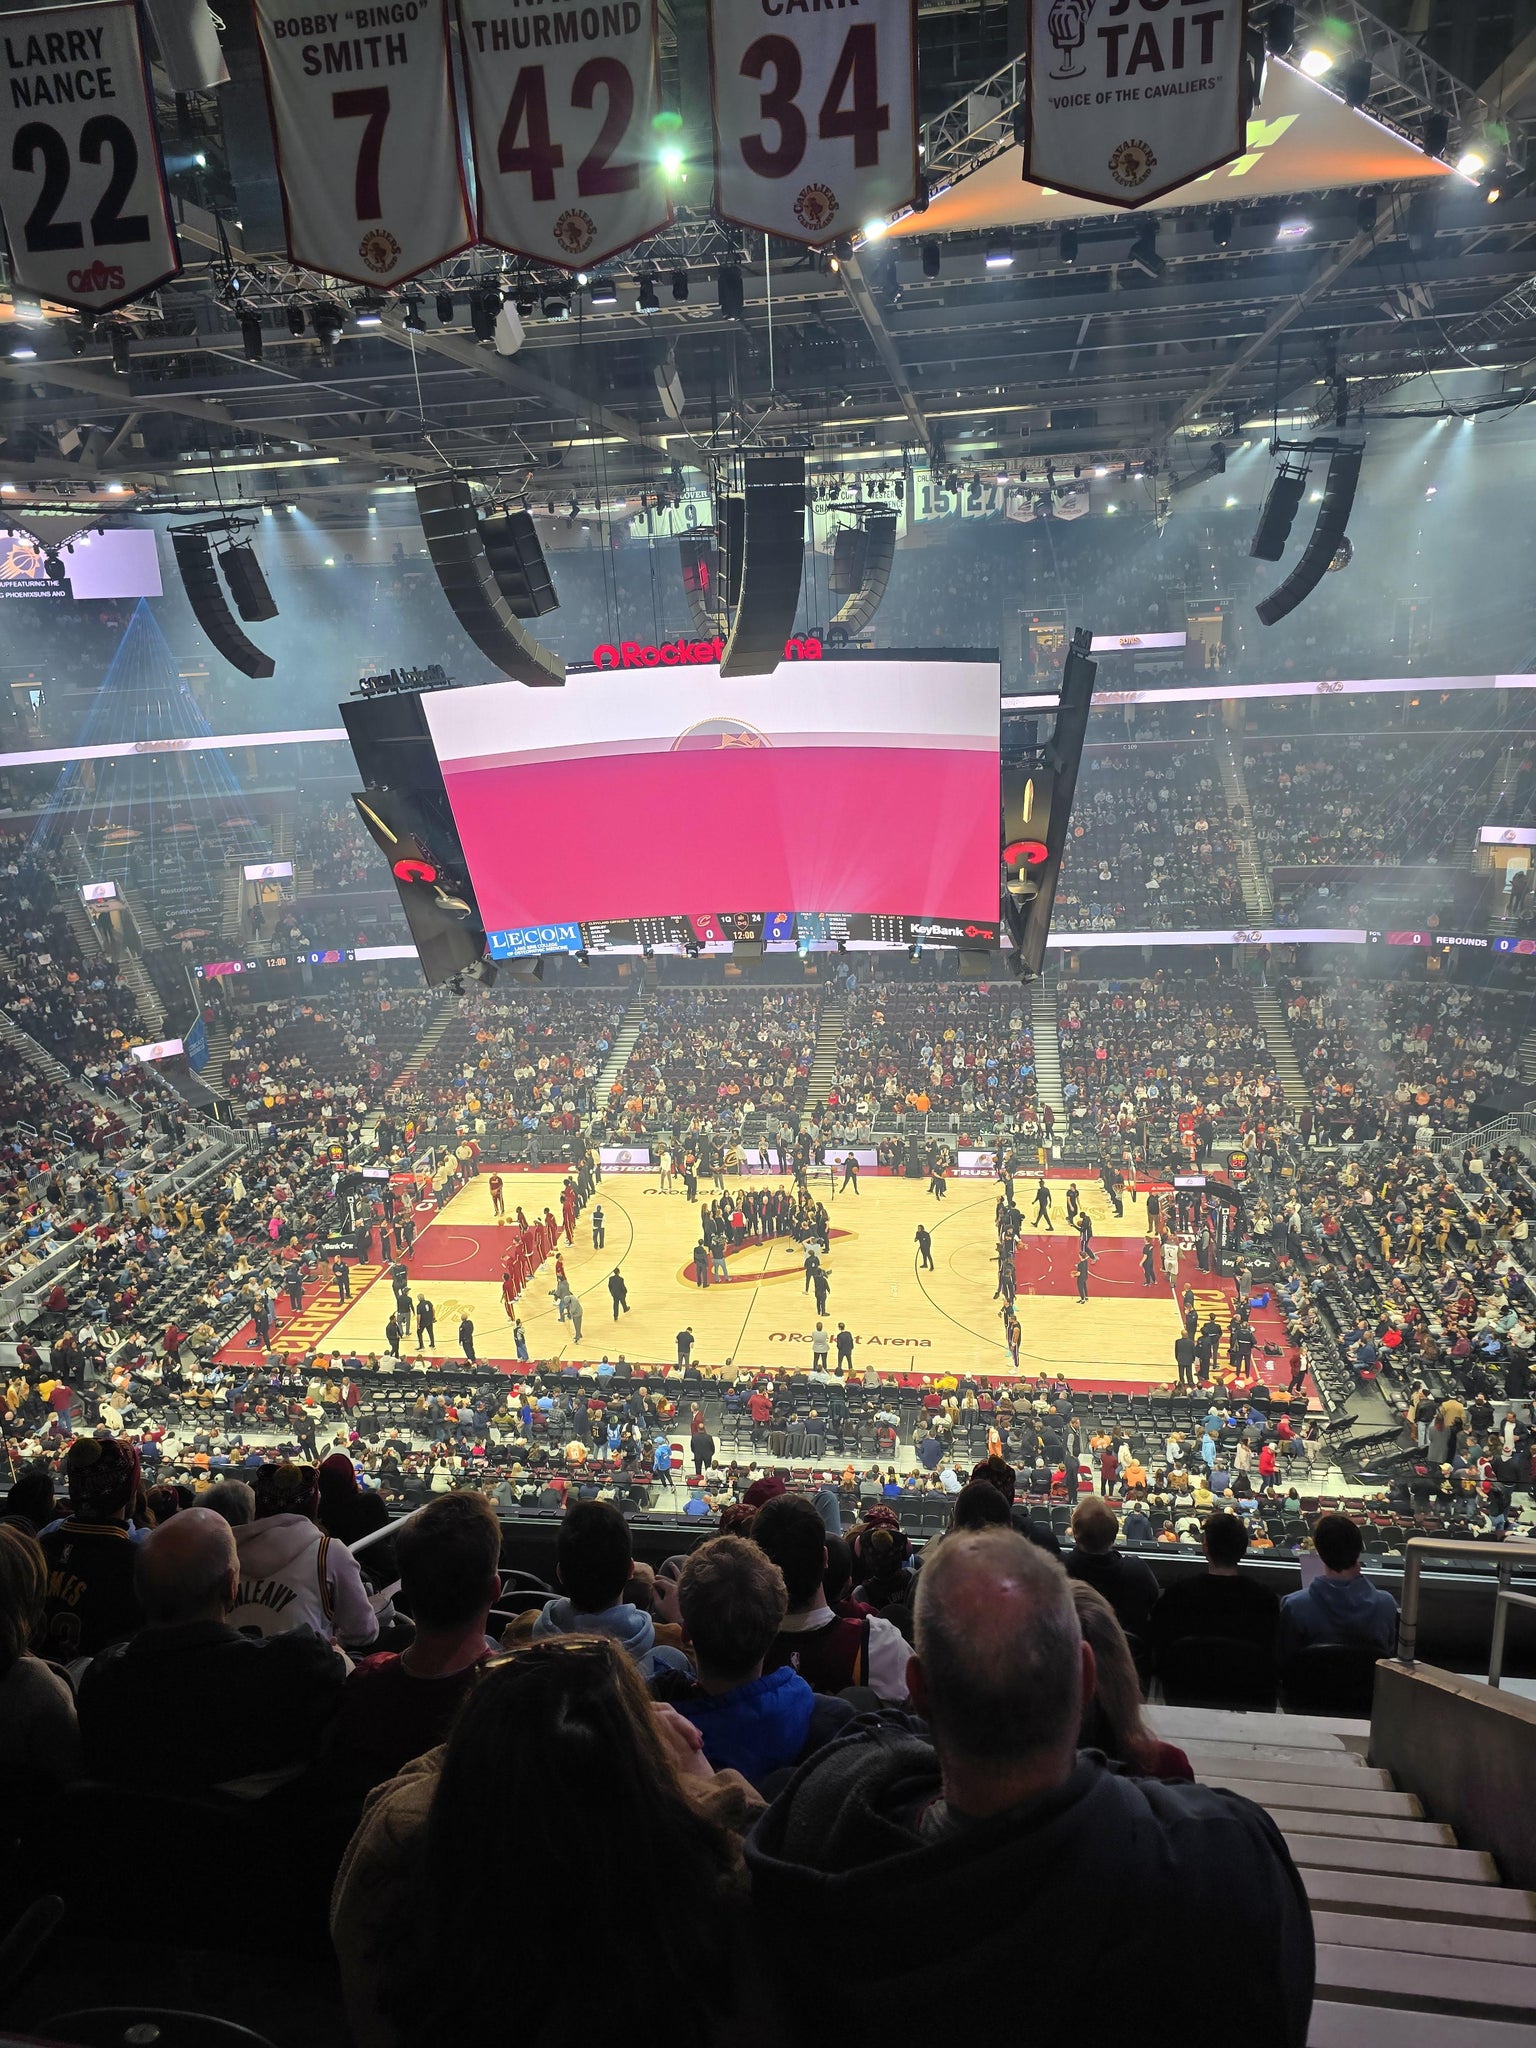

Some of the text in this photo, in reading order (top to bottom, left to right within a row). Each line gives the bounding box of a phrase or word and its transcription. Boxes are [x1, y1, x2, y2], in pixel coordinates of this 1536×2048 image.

[274, 0, 428, 39] BOBBY “BINGO”
[472, 2, 641, 53] THURMOND
[4, 27, 104, 69] LARRY
[302, 33, 408, 76] SMITH
[1097, 10, 1224, 79] TAIT
[10, 67, 116, 109] NANCE
[739, 22, 890, 180] 34
[1048, 93, 1091, 110] “VOICE
[1096, 91, 1113, 105] OF
[1116, 88, 1140, 102] THE
[497, 56, 641, 202] 42
[332, 86, 391, 221] 7
[1108, 139, 1158, 171] CAVALIERS
[12, 114, 151, 253] 22
[1112, 168, 1152, 188] CLEVELAND
[793, 183, 840, 214] CAVALIERS
[553, 208, 598, 238] CAVALIERS
[359, 229, 402, 258] CAVALIERS
[67, 260, 125, 293] CAVS
[921, 486, 950, 513] 15
[684, 504, 698, 529] 9
[620, 635, 725, 669] Rocket
[751, 914, 762, 922] 24
[910, 923, 964, 936] KeyBank
[705, 929, 714, 939] 0
[733, 931, 755, 940] 12:00
[772, 927, 781, 938] 0
[1413, 934, 1421, 944] 0
[1436, 936, 1488, 947] REBOUNDS
[1500, 940, 1509, 950] 0
[233, 962, 242, 972] 0
[246, 961, 256, 969] 1Q
[266, 957, 287, 968] 12:00
[297, 955, 306, 963] 24
[311, 953, 319, 963] 0
[789, 1333, 932, 1347] Rokt Arena
[228, 1579, 298, 1613] NLEAVY
